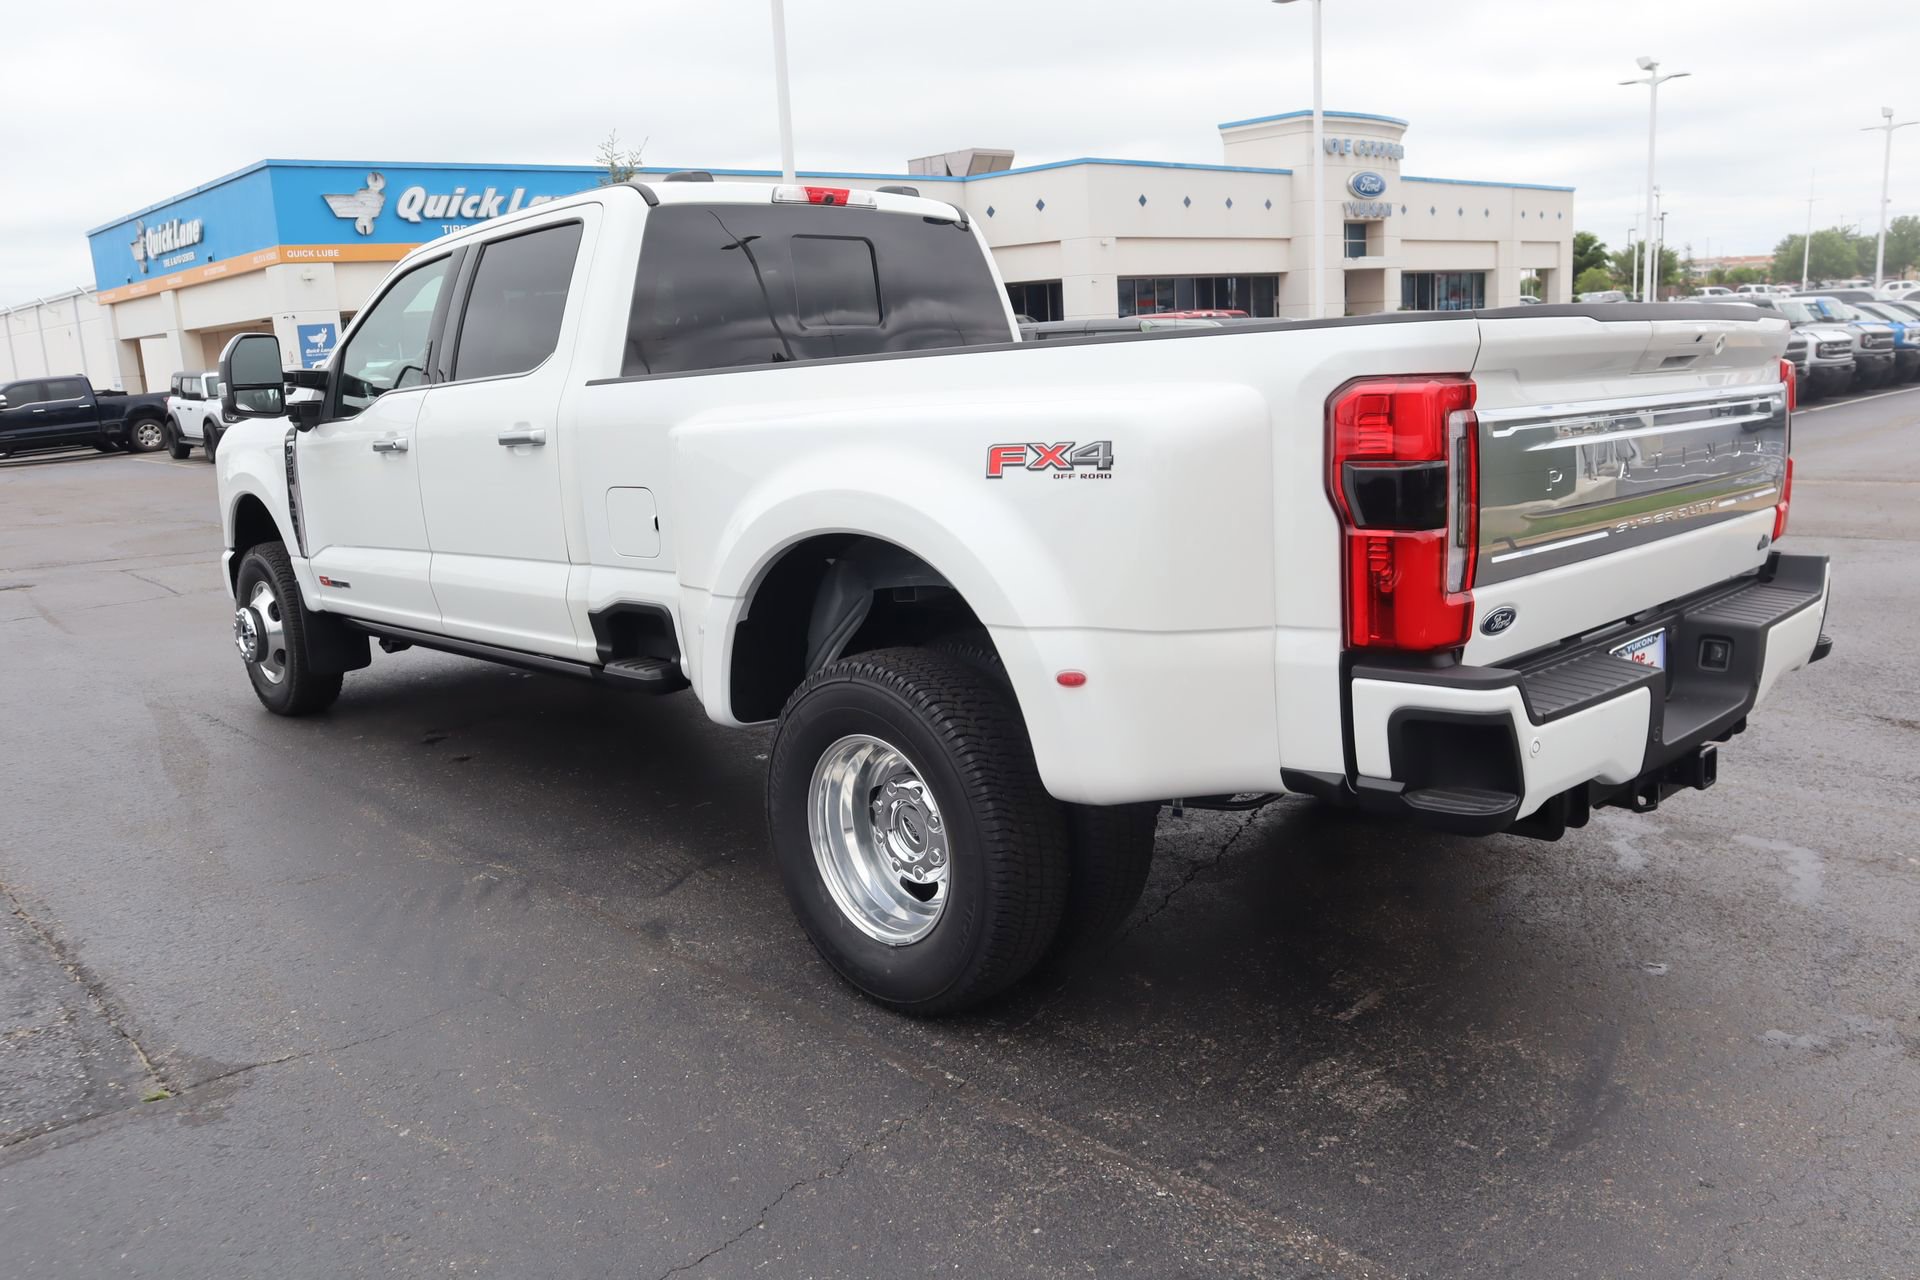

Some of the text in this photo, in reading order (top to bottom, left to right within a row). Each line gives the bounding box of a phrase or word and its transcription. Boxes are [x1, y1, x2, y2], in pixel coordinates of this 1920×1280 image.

[1360, 175, 1381, 192] Ford
[397, 186, 504, 222] Quick
[145, 218, 203, 260] Quick Lane
[287, 248, 340, 258] QUICK LUBE
[986, 440, 1114, 479] FX4
[1615, 500, 1717, 534] SUPER DUTY
[1491, 612, 1513, 631] Ford
[1626, 636, 1654, 652] YUKON
